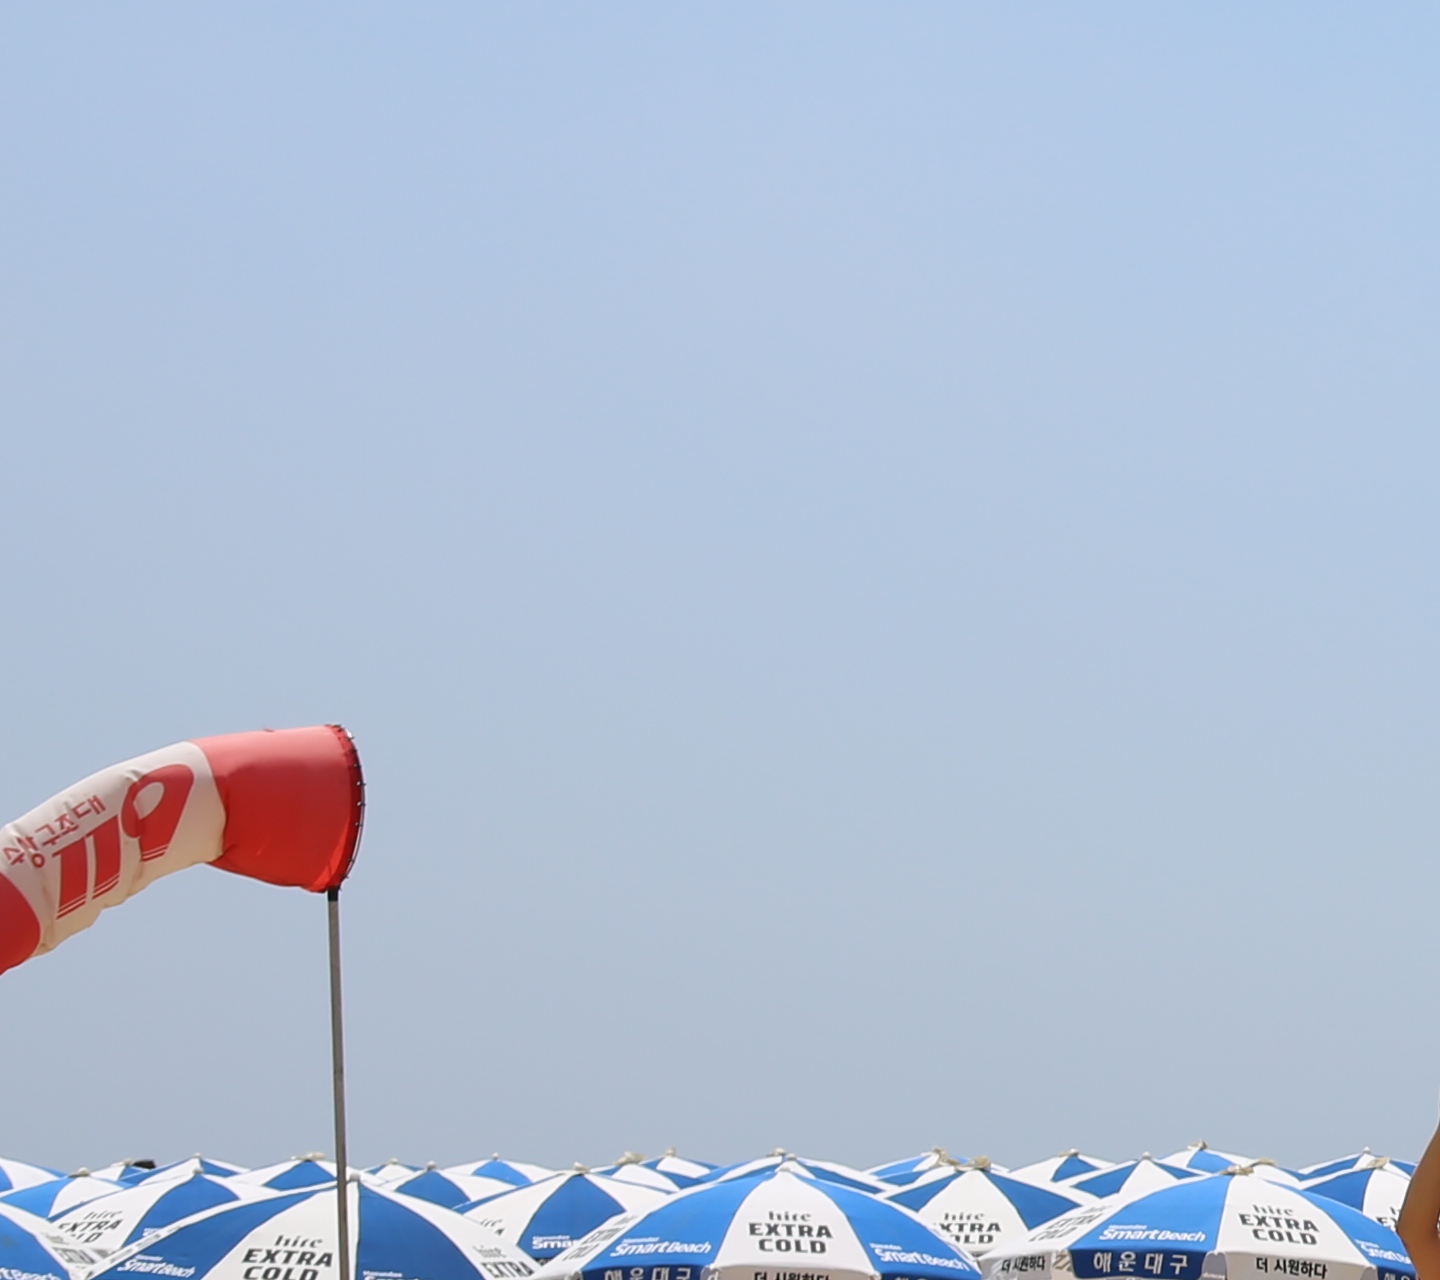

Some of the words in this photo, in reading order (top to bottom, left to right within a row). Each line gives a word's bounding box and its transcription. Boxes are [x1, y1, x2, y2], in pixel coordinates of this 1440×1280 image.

[52, 763, 195, 920] 119
[749, 1222, 833, 1239] EXTRA
[1238, 1213, 1320, 1233] EXTRA
[758, 1238, 827, 1254] COLD
[1252, 1229, 1317, 1246] COLD
[241, 1248, 334, 1268] EXTRA
[1256, 1257, 1268, 1273] 더
[1274, 1258, 1328, 1280] 시원하다
